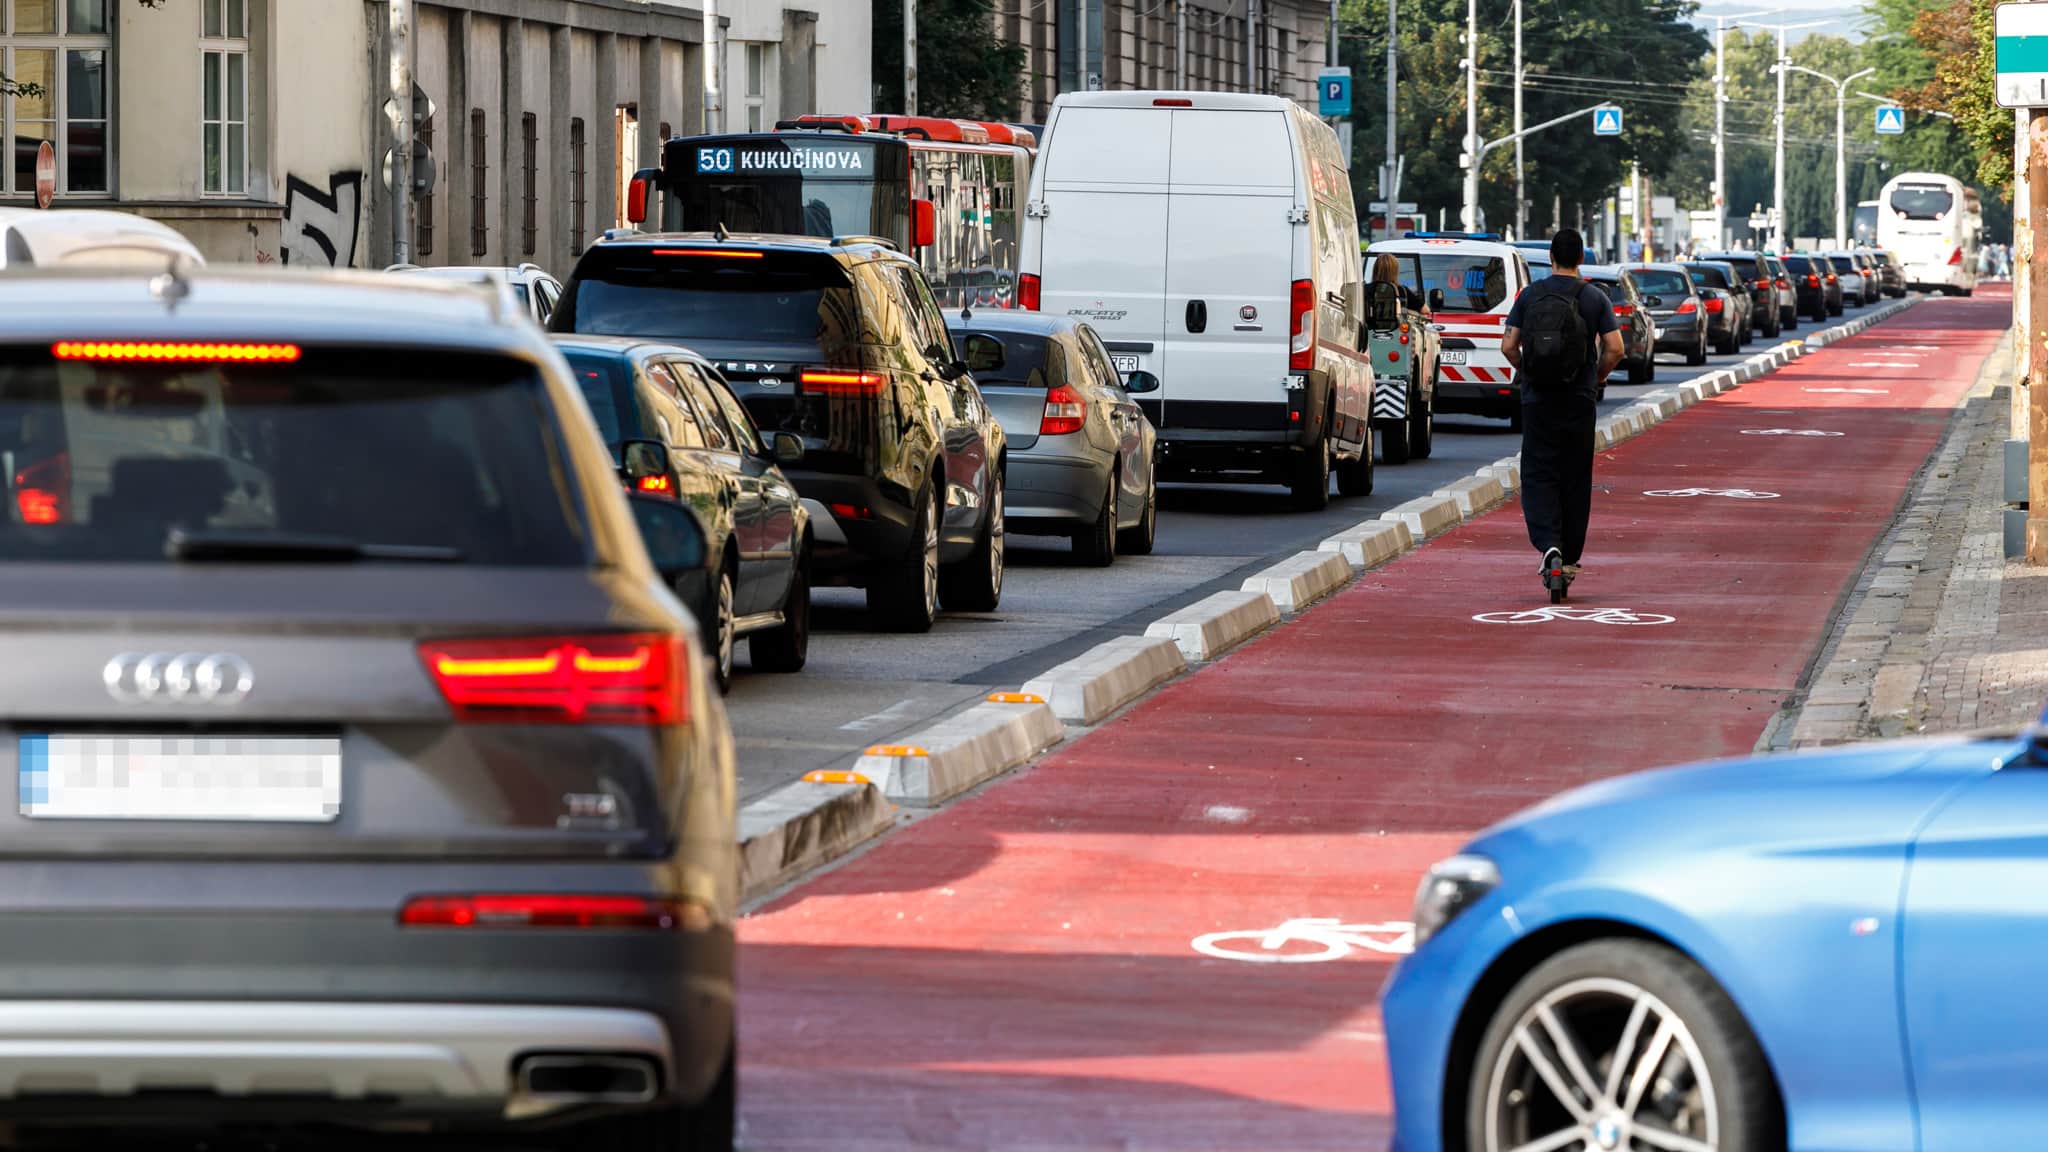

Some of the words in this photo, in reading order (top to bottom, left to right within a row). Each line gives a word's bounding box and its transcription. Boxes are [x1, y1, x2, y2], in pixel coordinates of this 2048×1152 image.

[1329, 83, 1340, 99] P
[700, 149, 731, 171] 50
[741, 148, 862, 169] KUKUČÍNOVA
